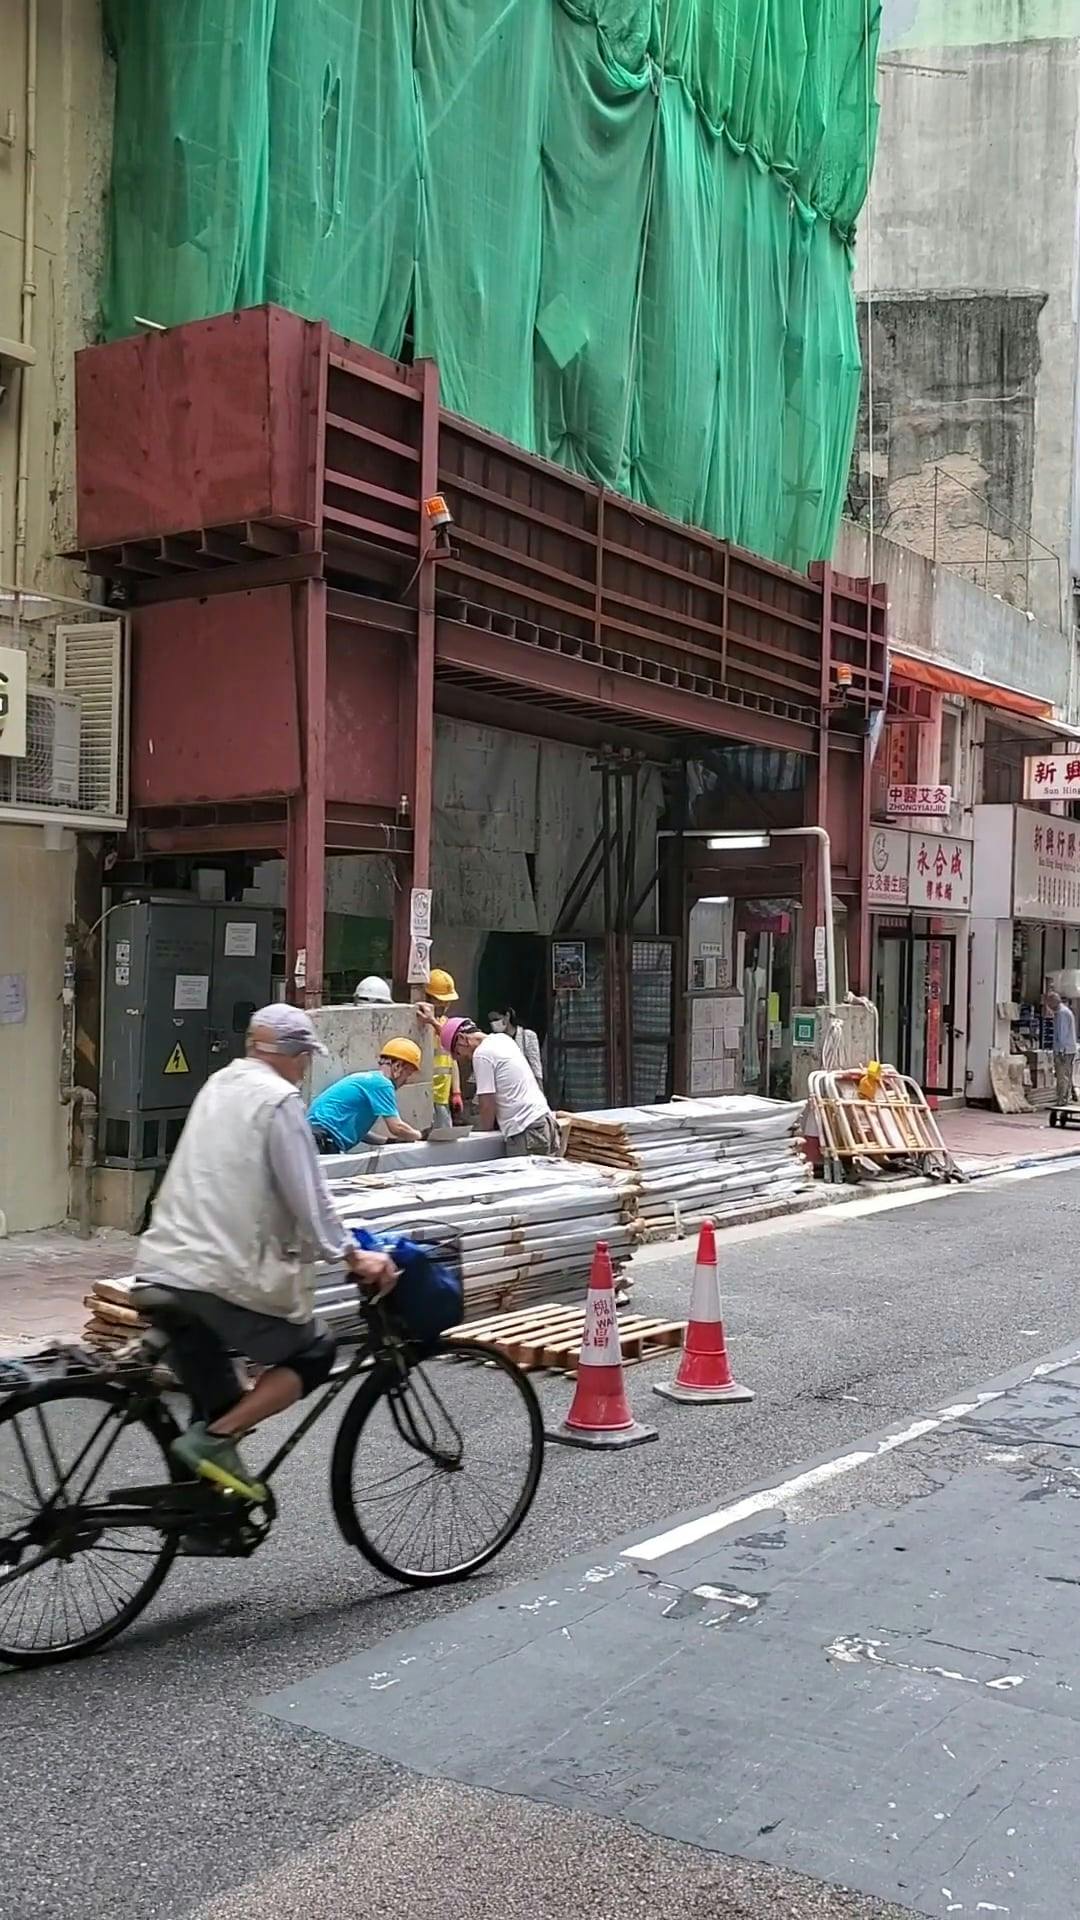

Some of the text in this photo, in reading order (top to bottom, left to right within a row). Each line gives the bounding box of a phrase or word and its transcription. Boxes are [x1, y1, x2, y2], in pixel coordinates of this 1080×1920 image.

[1034, 760, 1080, 784] 新興
[889, 786, 947, 804] 中醫艾灸
